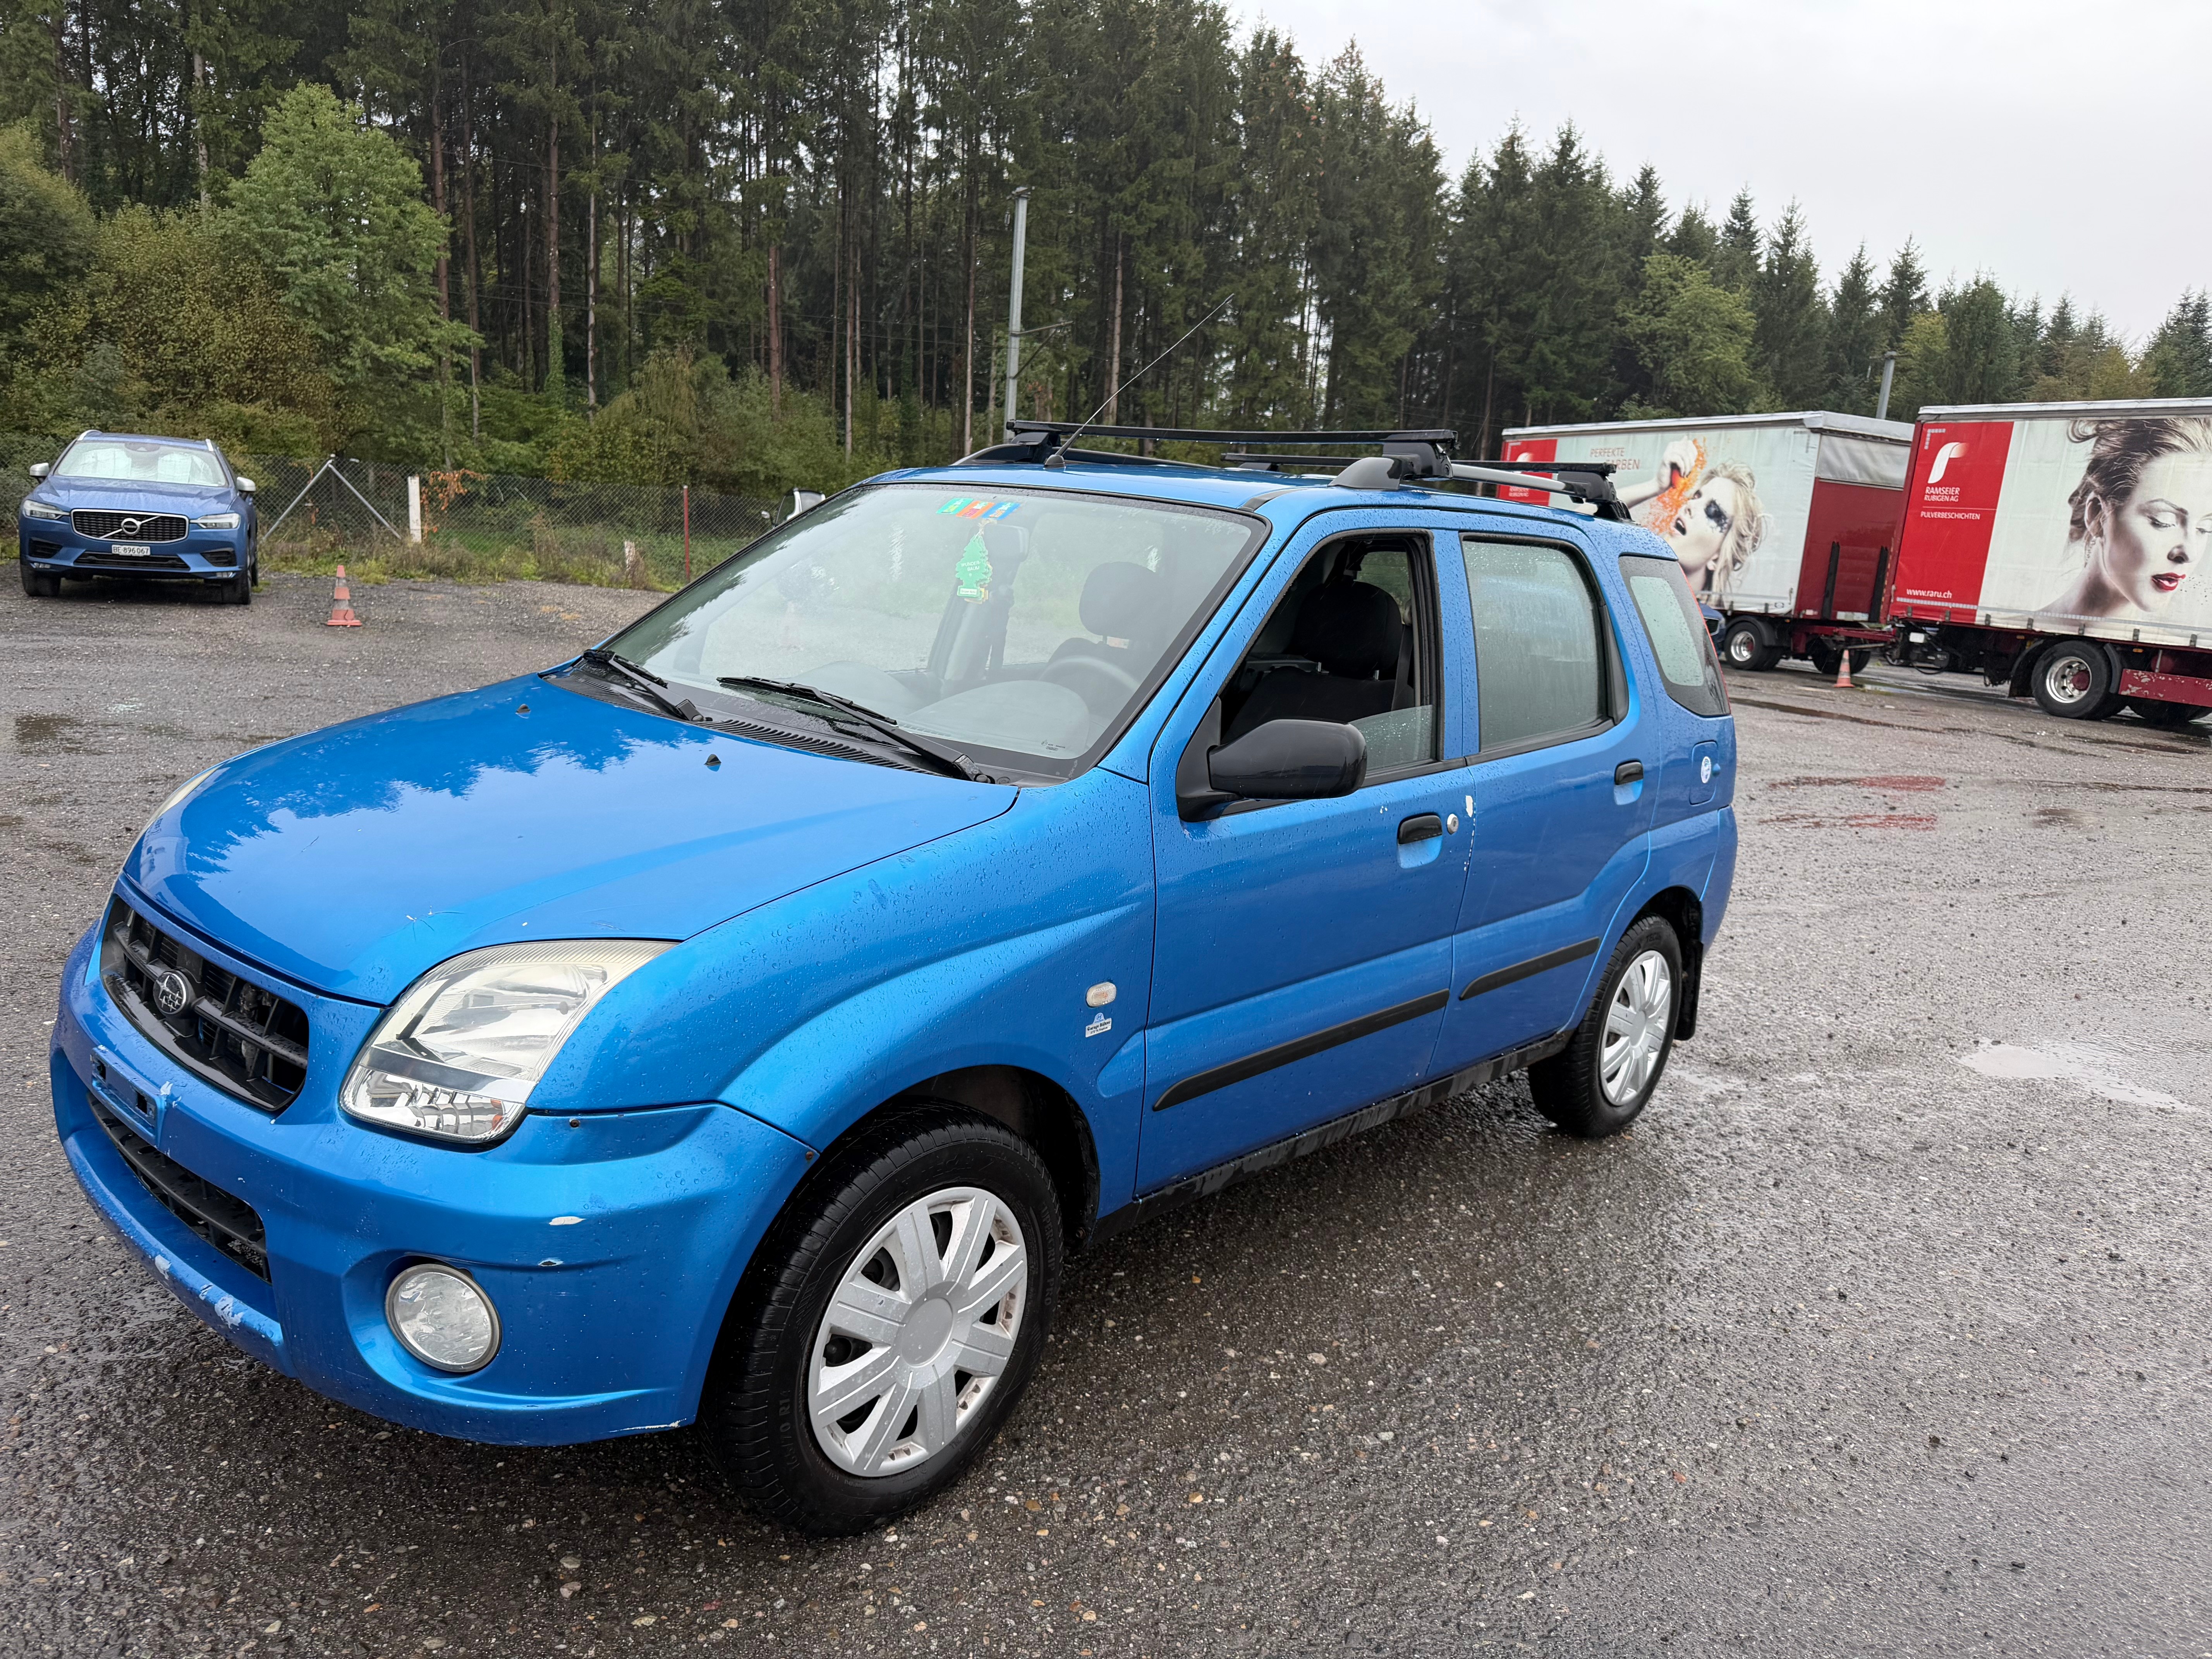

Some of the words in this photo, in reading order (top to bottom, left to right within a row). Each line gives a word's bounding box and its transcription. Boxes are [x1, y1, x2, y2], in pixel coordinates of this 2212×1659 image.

[1590, 447, 1625, 457] PERFEKTE
[1925, 486, 1960, 495] RAMSEIER
[1920, 511, 1980, 520] PULVERBESCHICHTEN
[1906, 589, 1952, 599] www.raru.ch
[1044, 1278, 1054, 1306] PRO
